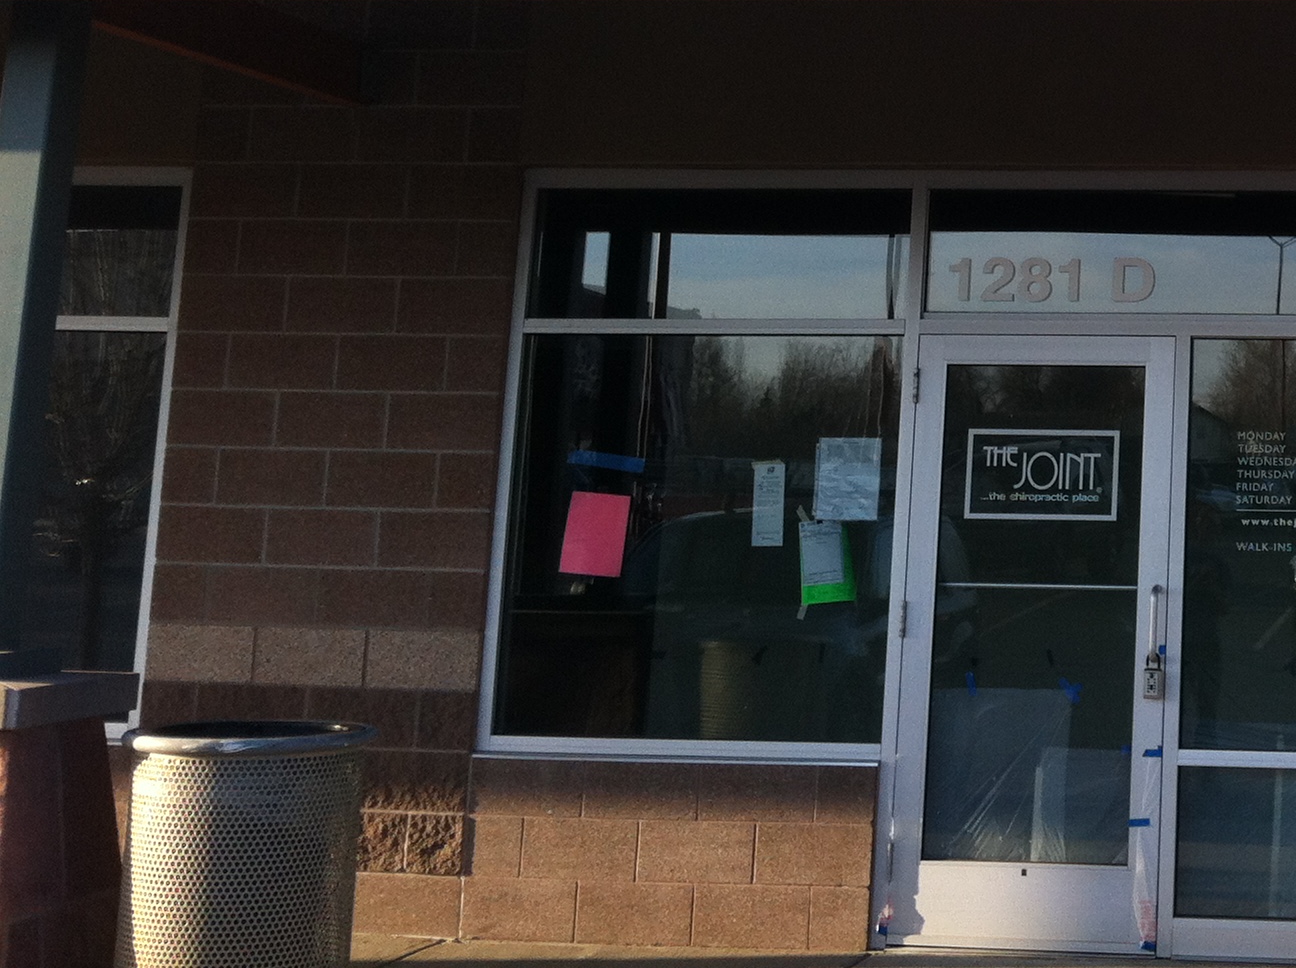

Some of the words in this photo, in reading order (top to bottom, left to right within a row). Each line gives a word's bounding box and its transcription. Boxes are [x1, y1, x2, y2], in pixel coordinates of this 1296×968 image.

[950, 256, 1081, 303] 1281
[1111, 256, 1156, 303] D
[1237, 431, 1286, 441] MONDAY
[1237, 444, 1286, 453] TUESDAY
[983, 446, 1018, 467] THE
[1013, 451, 1101, 490] JOINT
[1237, 469, 1295, 479] THURSDAY
[1236, 482, 1274, 492] FRIDAY
[1009, 492, 1069, 503] chiropractic
[1072, 493, 1100, 503] place
[1236, 495, 1293, 505] SATURDAY
[1236, 541, 1292, 552] WALK-INS
